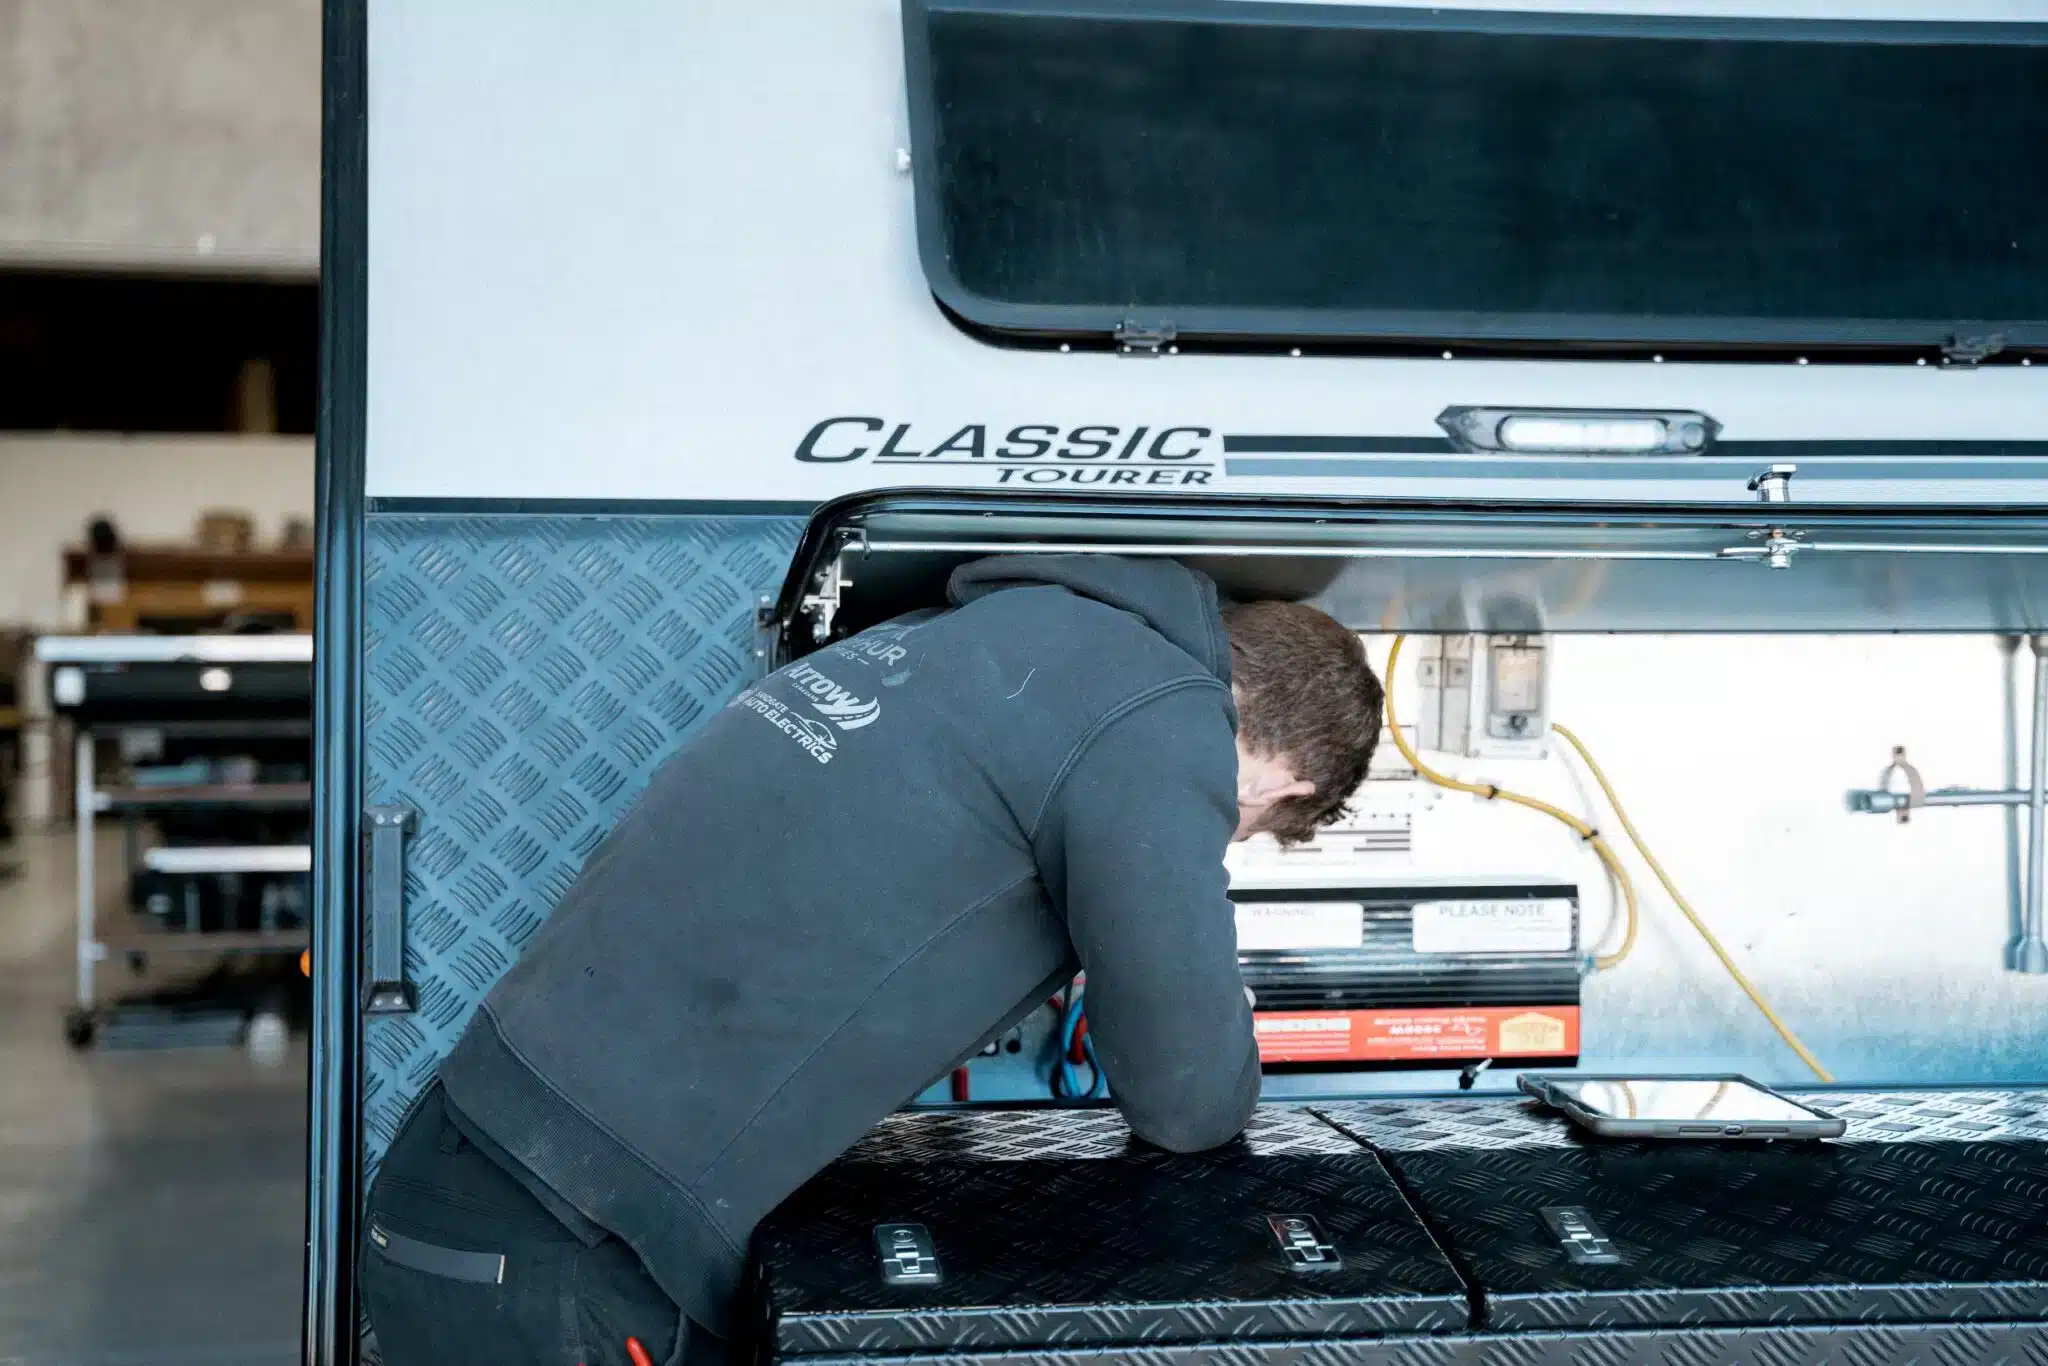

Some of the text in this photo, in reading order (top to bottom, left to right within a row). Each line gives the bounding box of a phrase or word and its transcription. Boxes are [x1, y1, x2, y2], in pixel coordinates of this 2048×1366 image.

[794, 416, 1212, 462] CLASSIC
[997, 468, 1213, 484] TOURER
[764, 709, 833, 764] ELECTRICS
[1440, 904, 1545, 917] PLEASE NOTE
